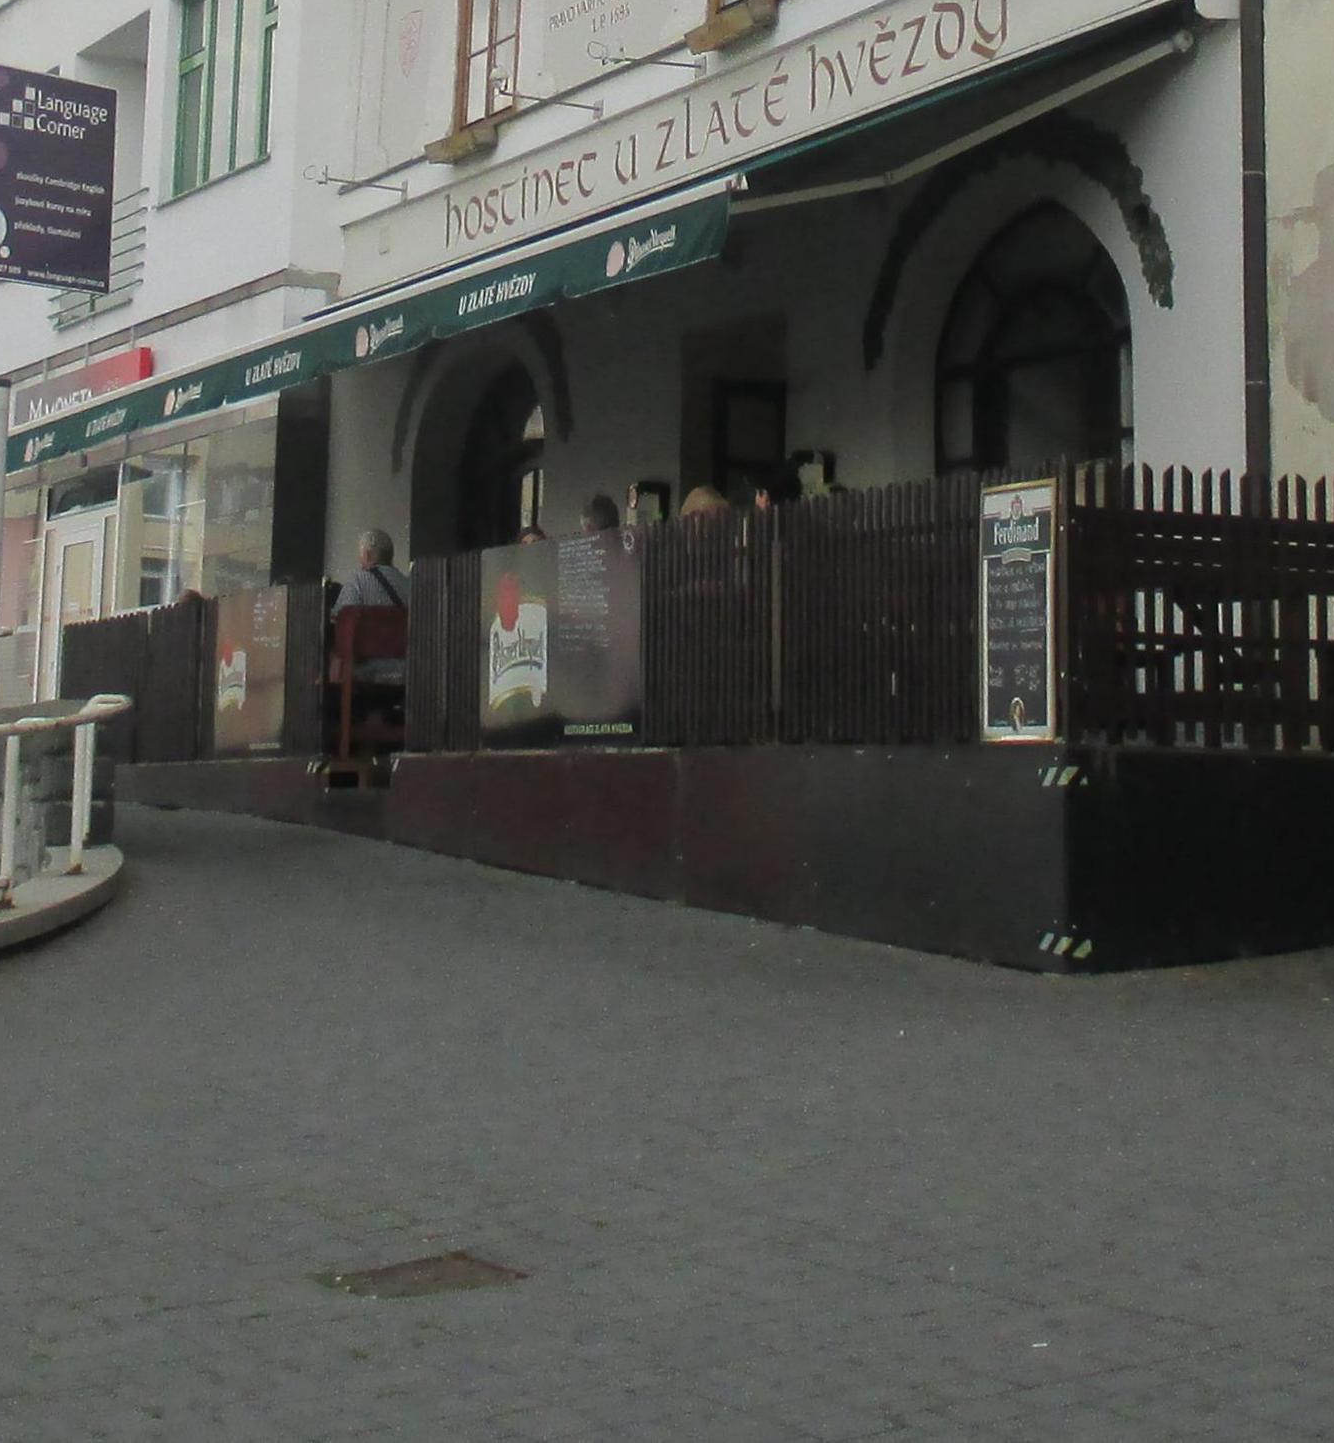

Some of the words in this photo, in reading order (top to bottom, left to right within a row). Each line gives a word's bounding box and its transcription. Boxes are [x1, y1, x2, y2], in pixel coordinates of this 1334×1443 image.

[38, 89, 108, 126] Language
[36, 114, 86, 140] Corner
[458, 296, 467, 316] U
[467, 280, 496, 313] ZLATÉ
[495, 272, 536, 304] HVĚZDY
[994, 516, 1039, 546] Ferdinand
